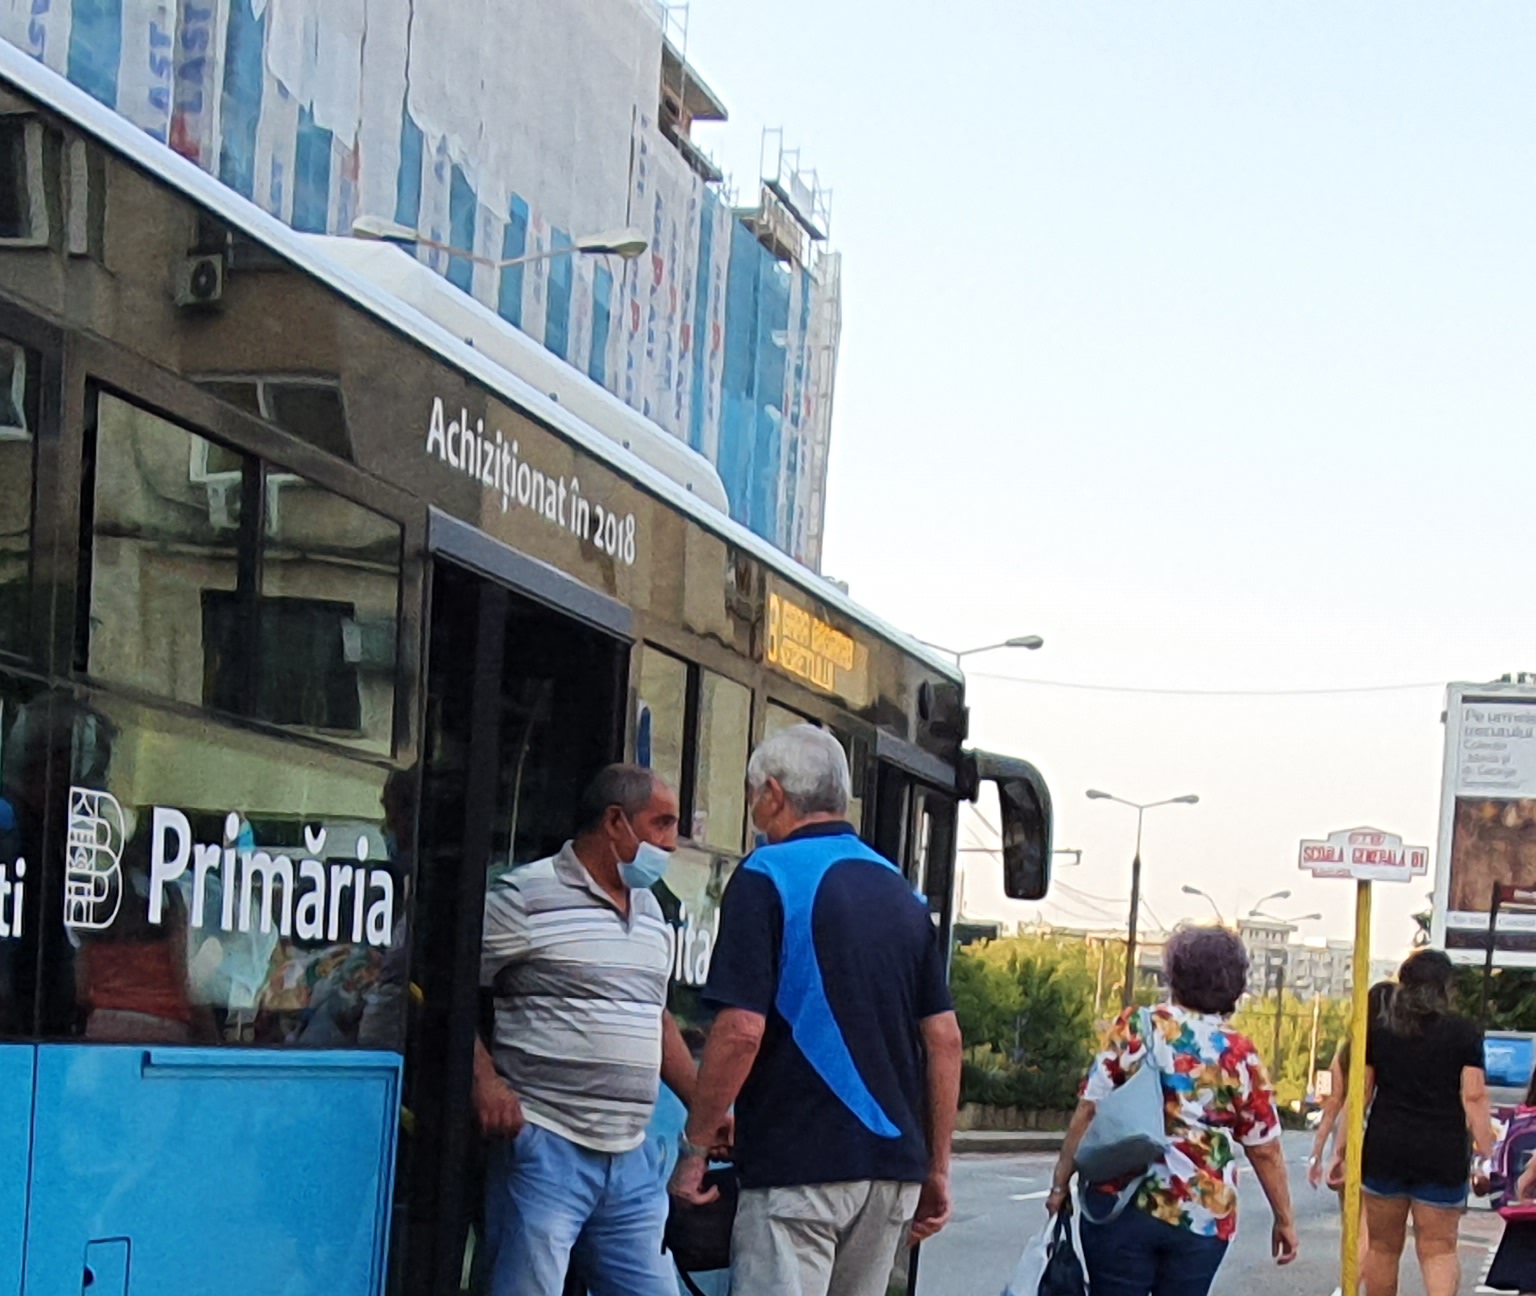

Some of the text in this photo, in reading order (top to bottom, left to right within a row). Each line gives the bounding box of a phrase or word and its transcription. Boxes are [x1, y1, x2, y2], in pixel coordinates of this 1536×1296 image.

[426, 396, 636, 566] Achiziționat în 2018
[147, 805, 395, 947] Primăria
